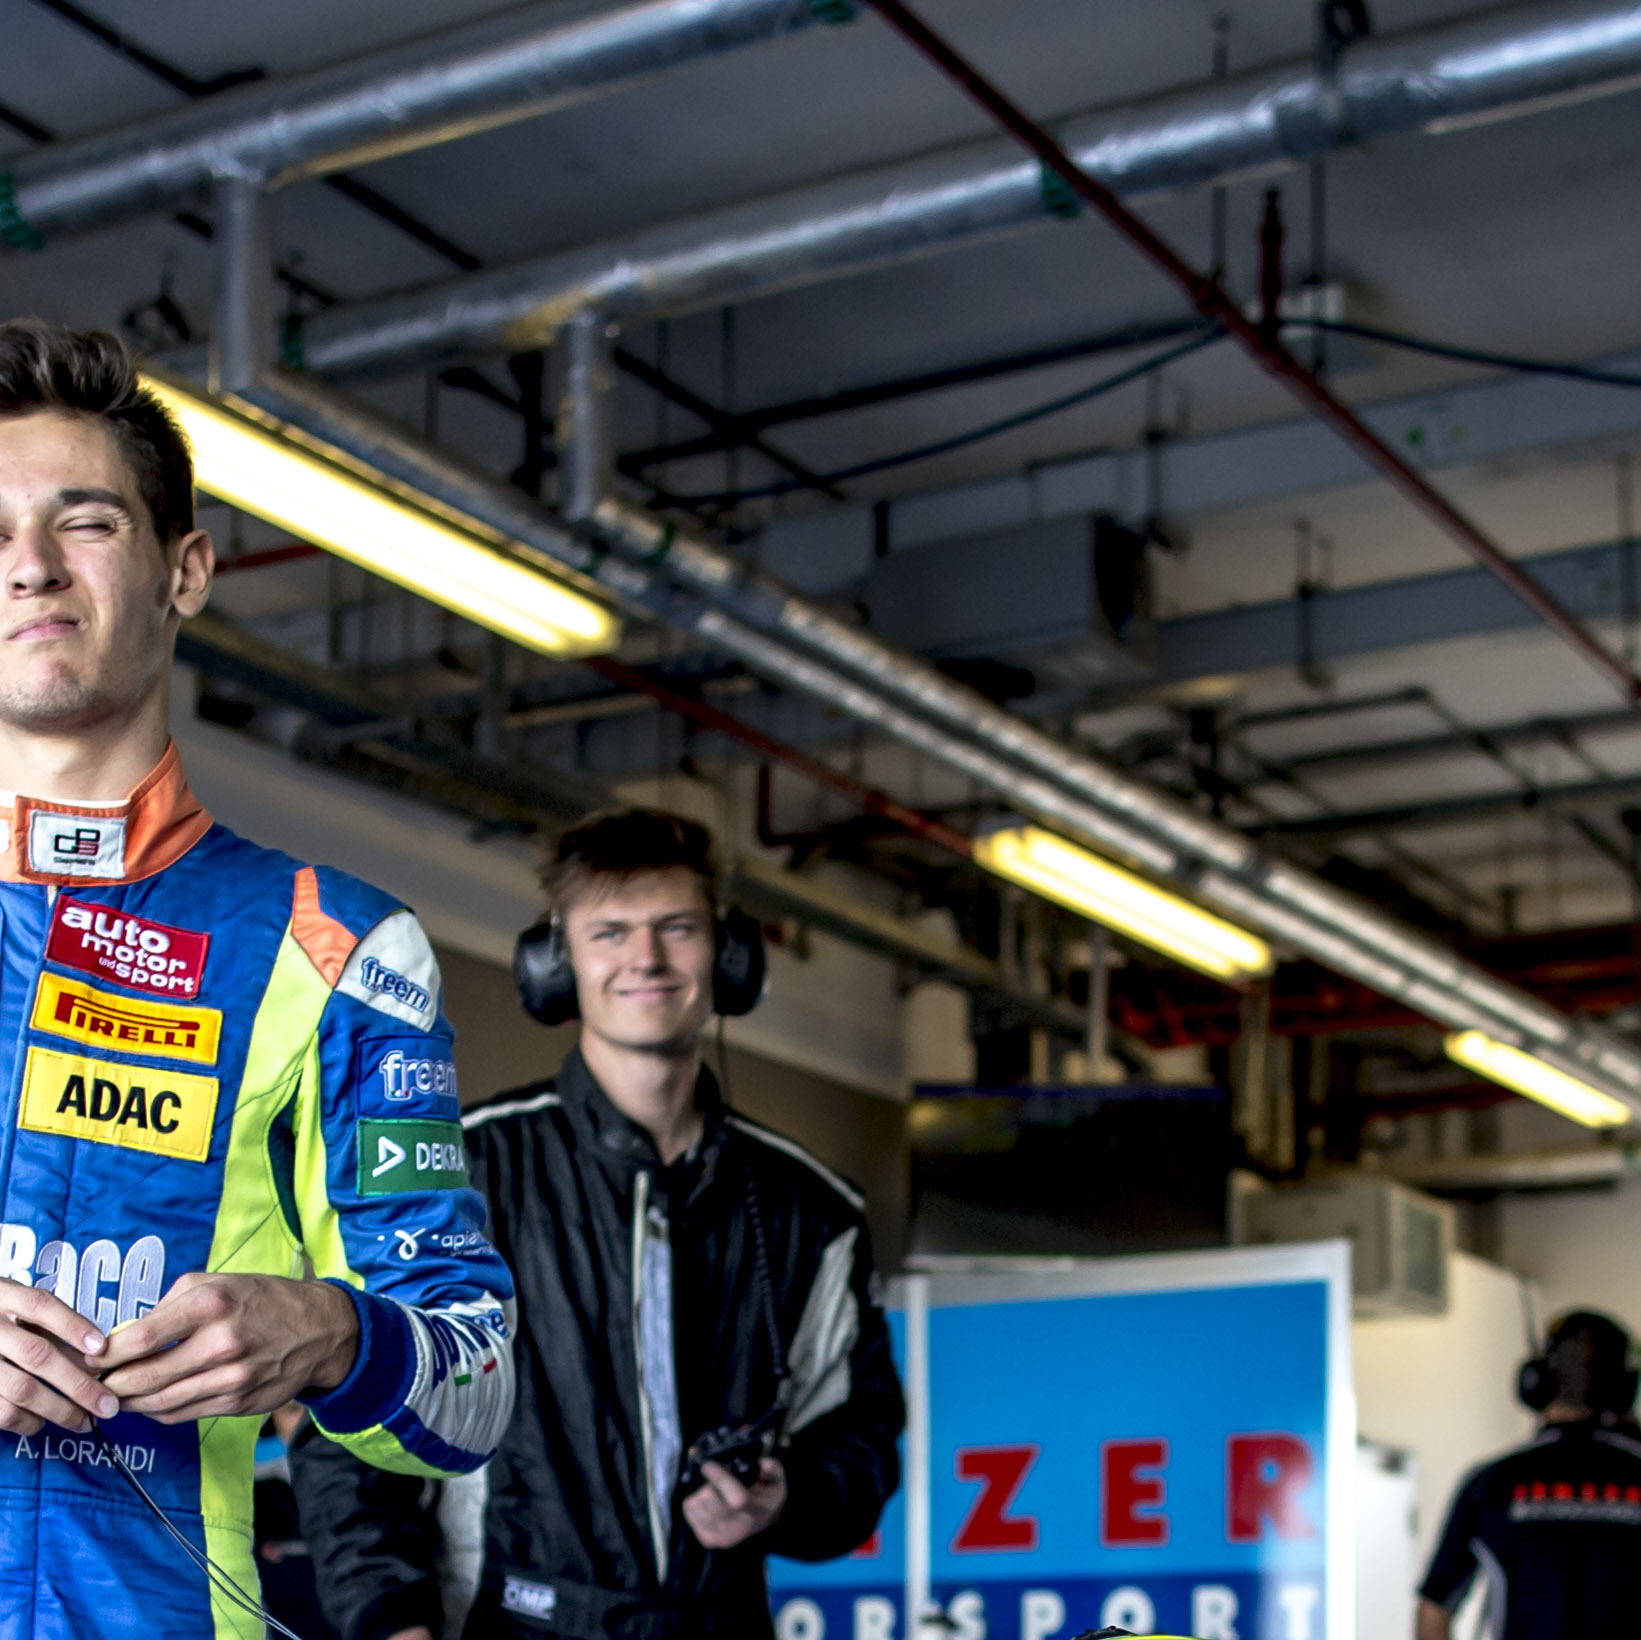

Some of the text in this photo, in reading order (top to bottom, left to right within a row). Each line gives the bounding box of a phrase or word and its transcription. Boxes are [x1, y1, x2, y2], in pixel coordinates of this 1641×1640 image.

[61, 906, 170, 953] auto
[81, 932, 187, 974] motor
[98, 956, 195, 993] und sport
[361, 957, 430, 1012] freem
[54, 992, 201, 1050] PIRELLI
[56, 1074, 182, 1134] ADAC
[14, 1435, 155, 1473] A. LORANDI
[504, 1580, 556, 1614] OMP
